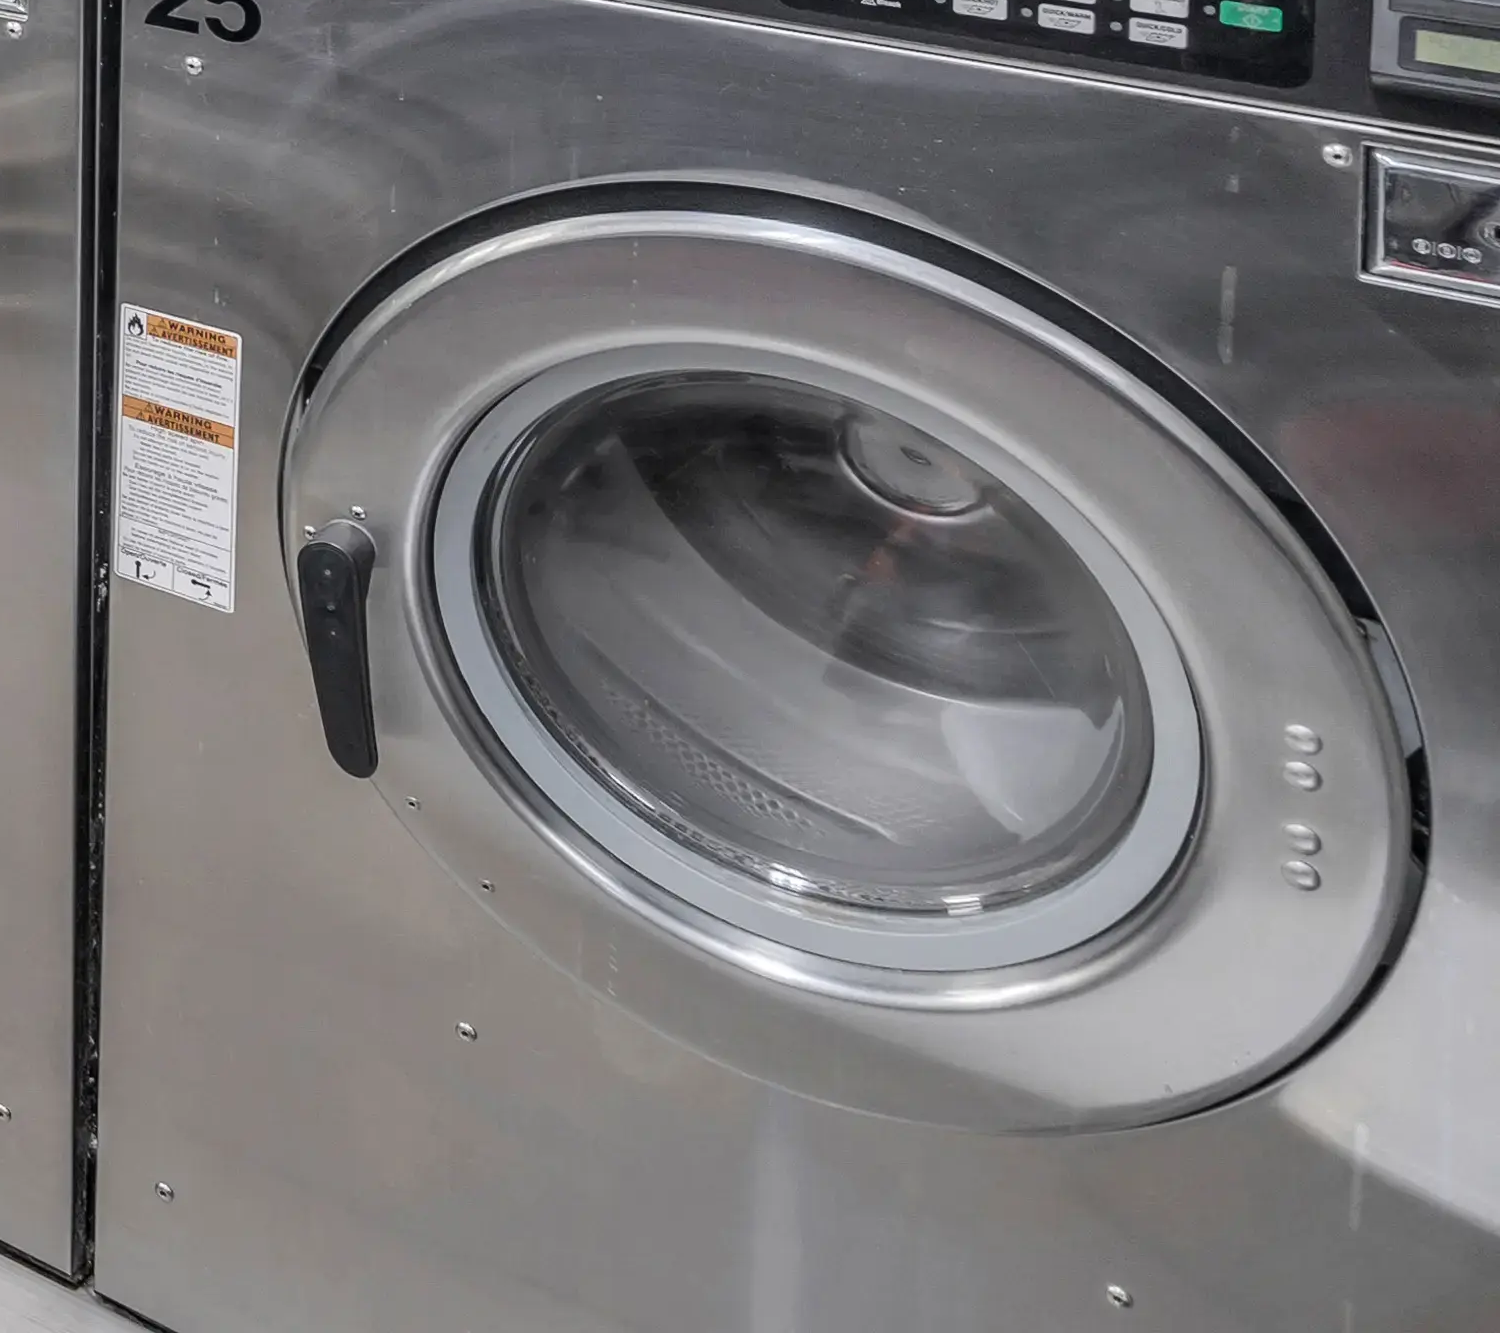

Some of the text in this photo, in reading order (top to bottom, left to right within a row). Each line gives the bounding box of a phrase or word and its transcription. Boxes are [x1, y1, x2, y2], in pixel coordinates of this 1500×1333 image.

[162, 331, 233, 357] AVERTISSEMENT
[168, 321, 226, 344] WARNING
[148, 414, 220, 443] AVERTISSEMENT
[154, 404, 213, 430] WARNING
